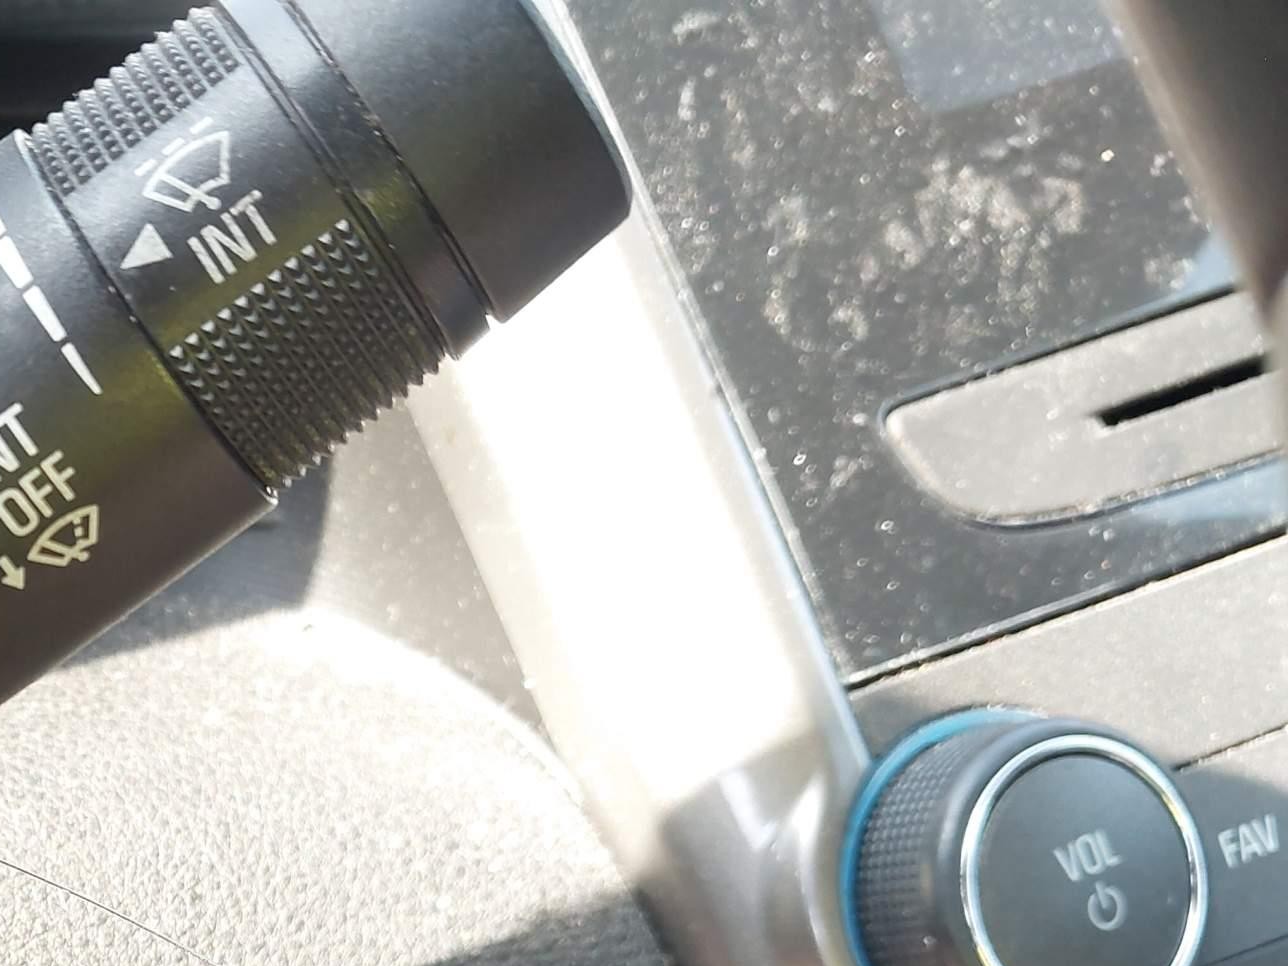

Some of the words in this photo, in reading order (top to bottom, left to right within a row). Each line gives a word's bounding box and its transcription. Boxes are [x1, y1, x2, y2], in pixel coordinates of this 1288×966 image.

[188, 190, 277, 284] INT
[1053, 829, 1122, 881] VOL
[1217, 814, 1280, 867] FAV
